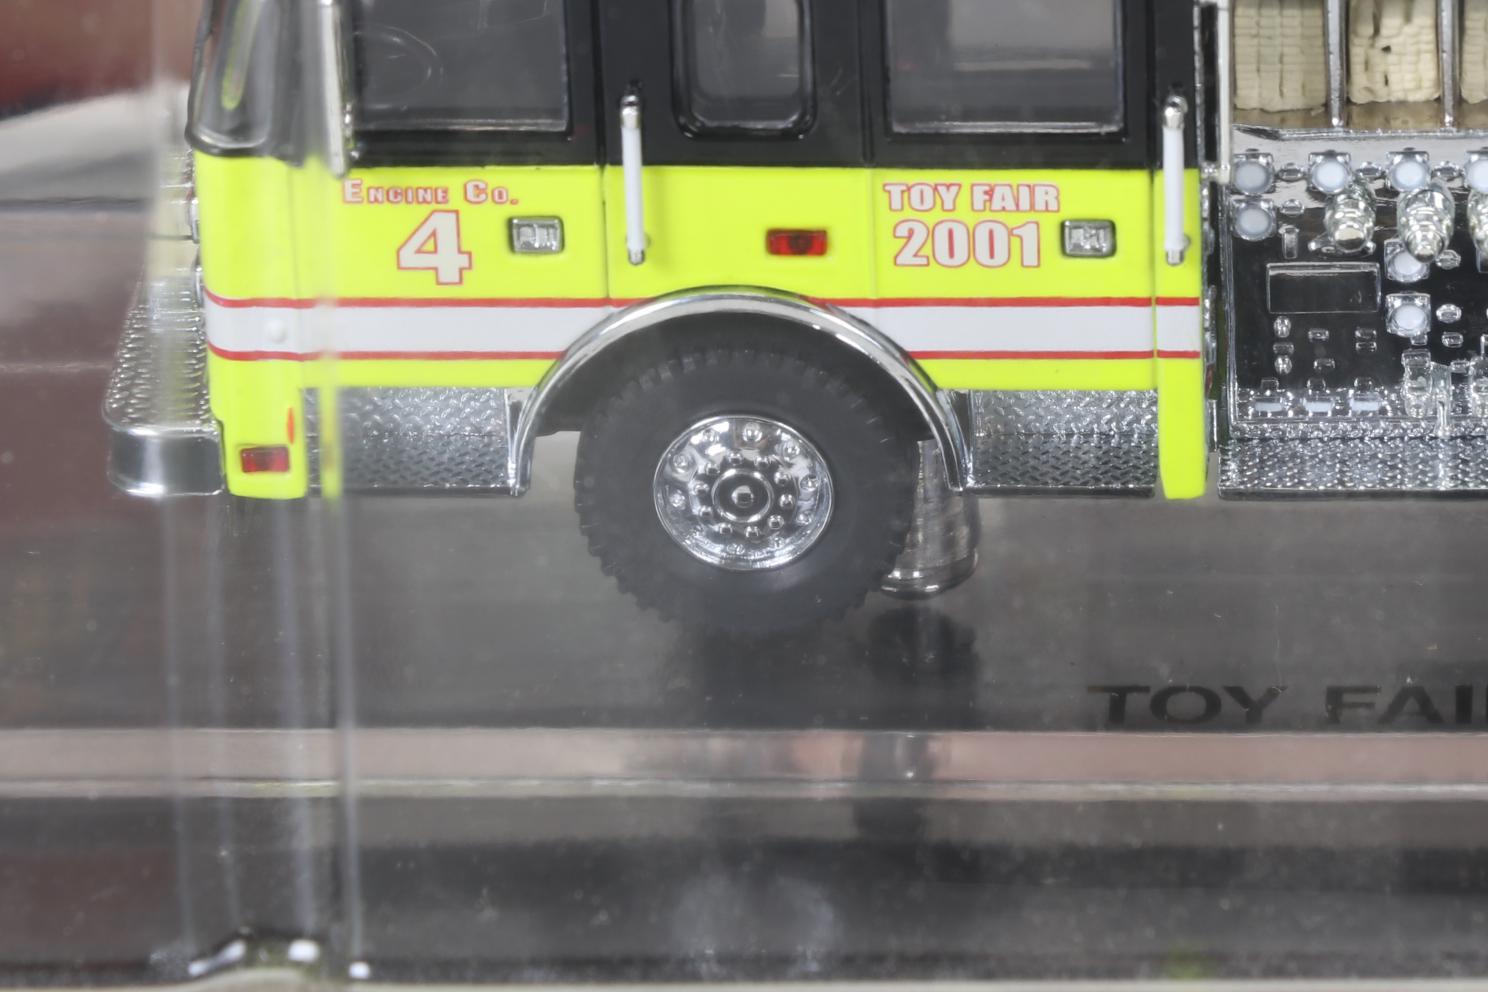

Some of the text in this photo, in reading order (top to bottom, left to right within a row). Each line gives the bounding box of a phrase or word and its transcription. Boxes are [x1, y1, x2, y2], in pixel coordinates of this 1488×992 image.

[883, 182, 1061, 213] TOY FAIR
[397, 209, 473, 286] 4
[893, 218, 1041, 268] 2001
[1087, 684, 1288, 725] TOY
